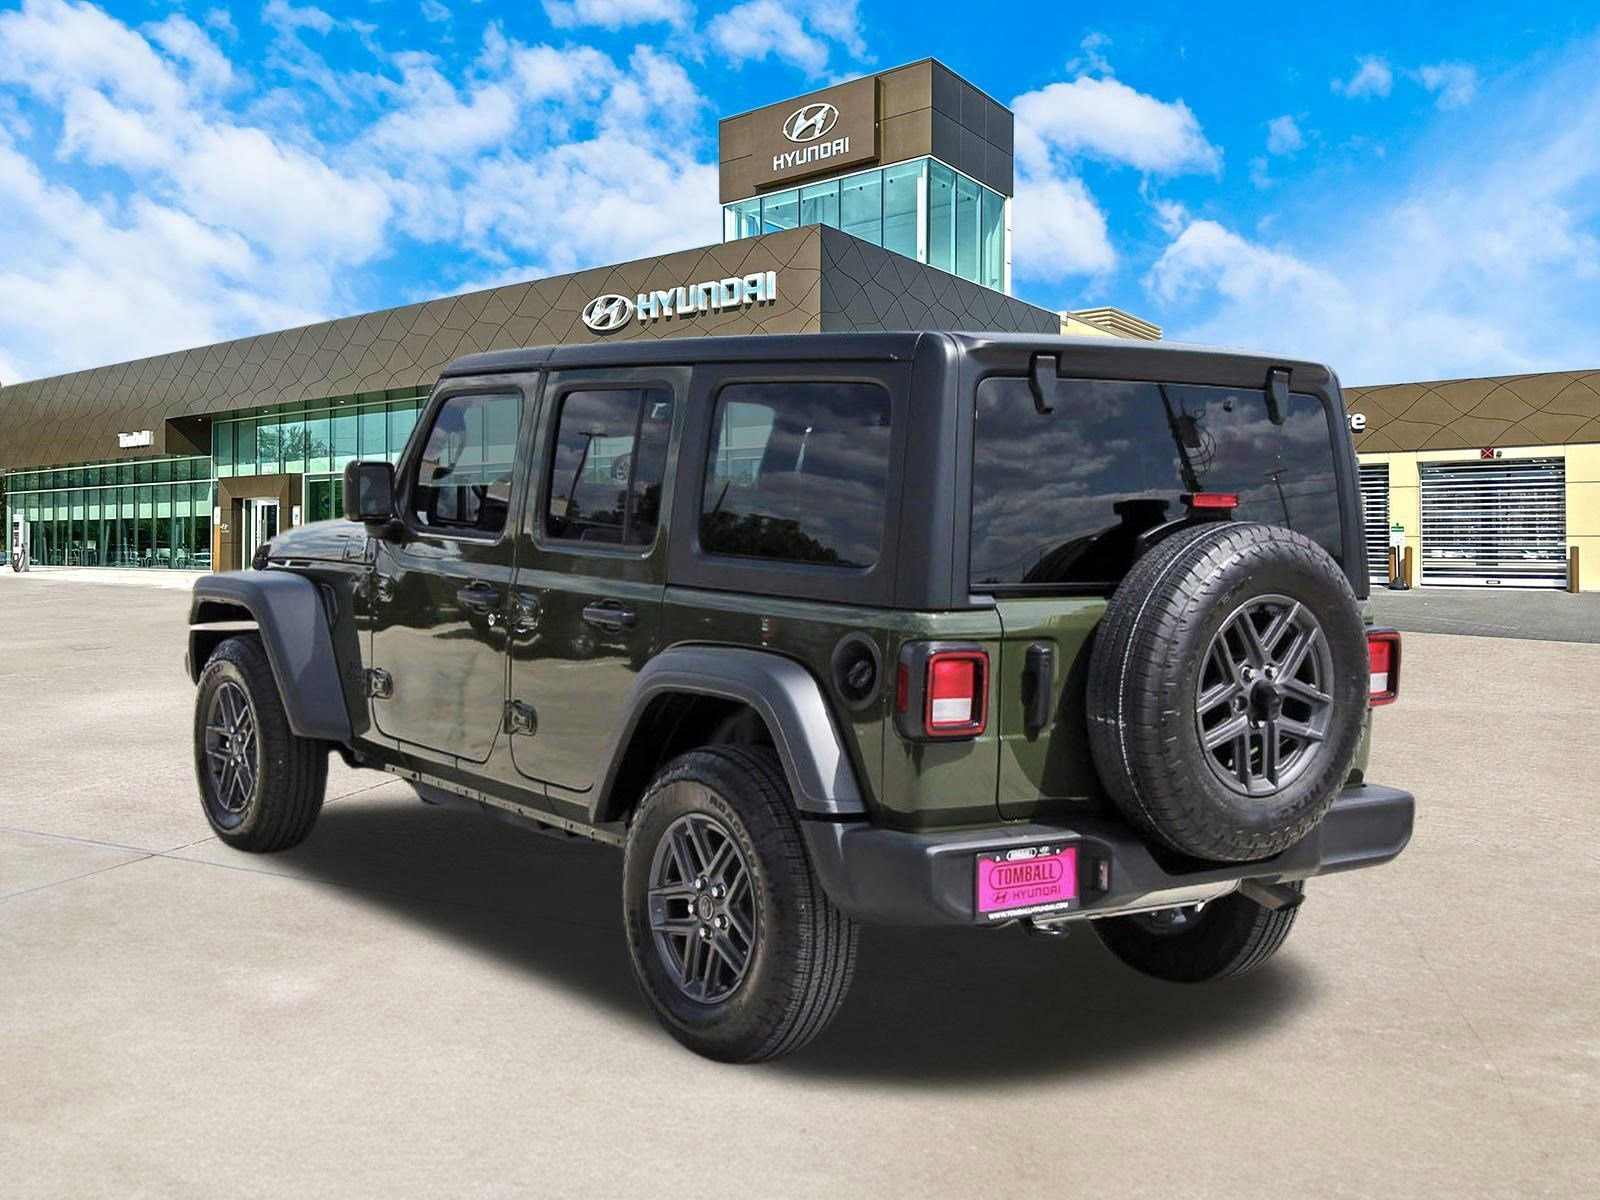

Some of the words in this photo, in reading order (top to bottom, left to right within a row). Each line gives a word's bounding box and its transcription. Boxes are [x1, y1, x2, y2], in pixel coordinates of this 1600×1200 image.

[773, 137, 849, 170] HYUNDAI
[637, 271, 777, 321] HYUNDAI
[997, 863, 1055, 886] TOMBALL
[1013, 885, 1061, 900] HYUNDAI
